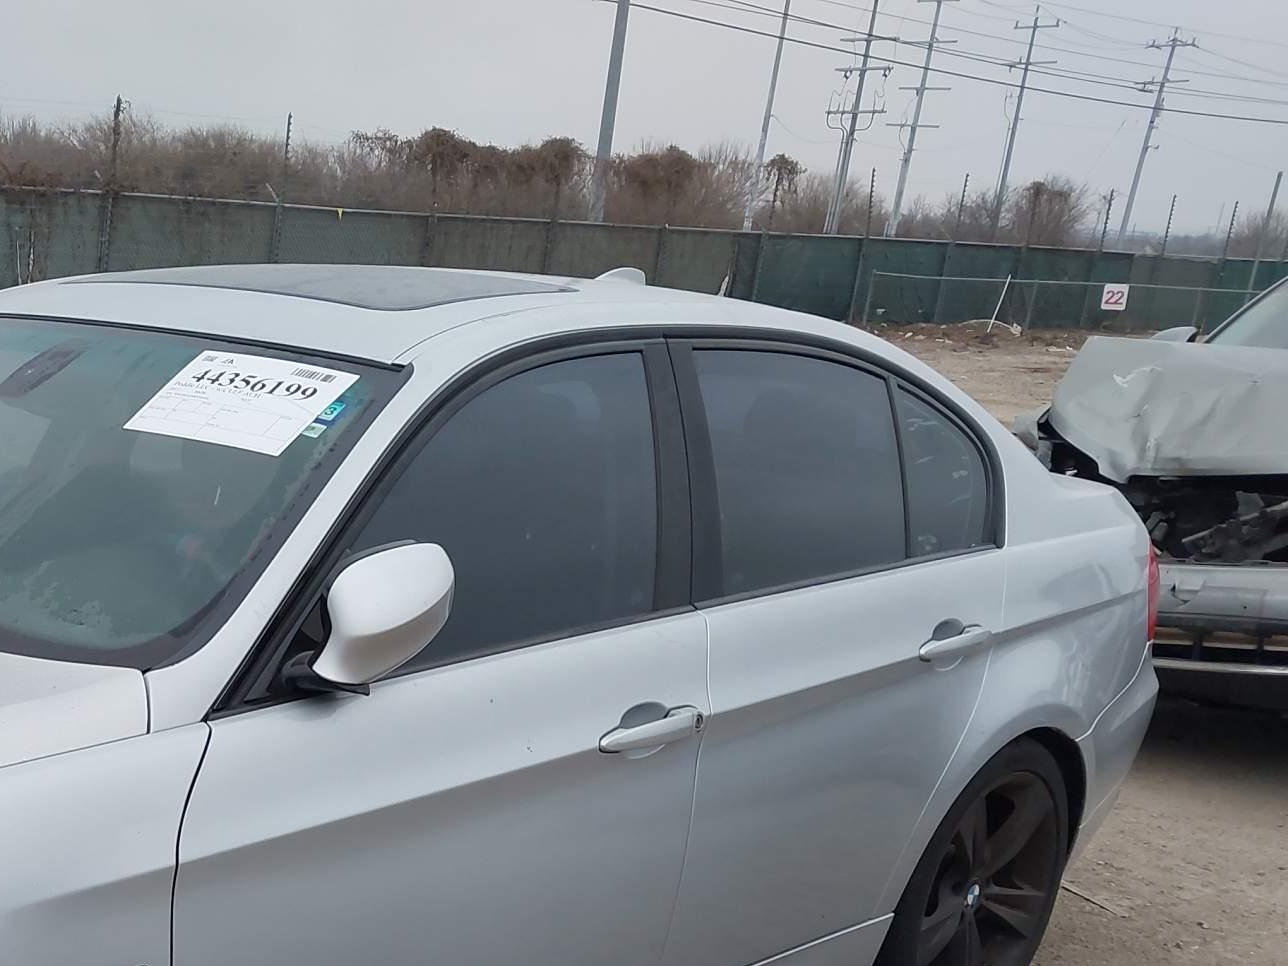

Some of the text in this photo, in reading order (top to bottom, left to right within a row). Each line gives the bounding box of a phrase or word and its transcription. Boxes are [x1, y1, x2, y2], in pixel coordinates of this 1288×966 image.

[1104, 290, 1124, 305] 22
[192, 368, 317, 401] 44356199
[324, 406, 337, 416] 3
